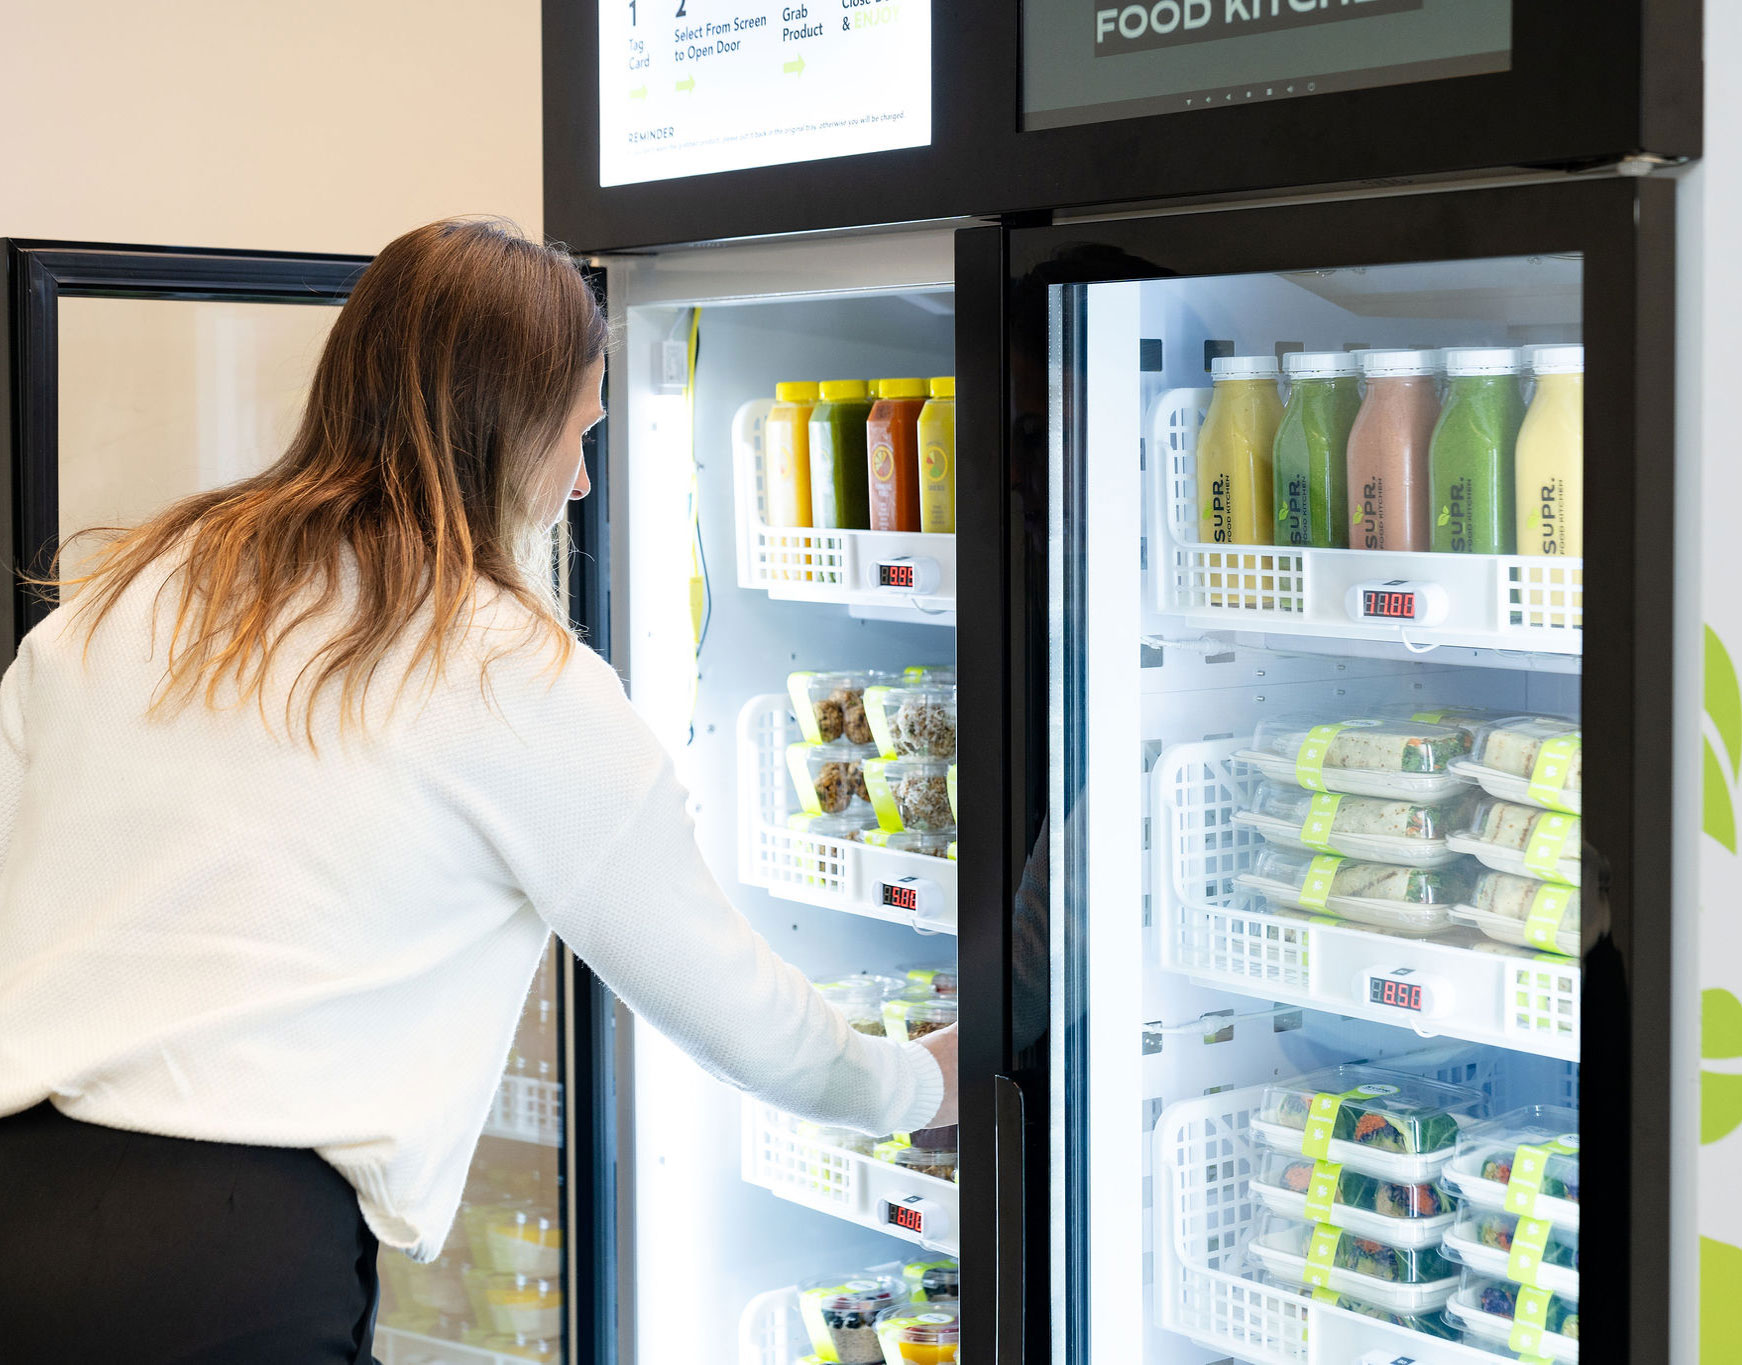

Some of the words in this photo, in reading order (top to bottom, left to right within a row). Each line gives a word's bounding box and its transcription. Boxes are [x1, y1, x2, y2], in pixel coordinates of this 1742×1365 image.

[629, 0, 637, 27] 1
[782, 3, 808, 22] Grab
[842, 16, 850, 31] &
[1096, 0, 1212, 44] FOOD
[674, 26, 703, 43] Select
[706, 22, 731, 37] From
[733, 15, 767, 32] Screen
[782, 22, 823, 42] Product
[629, 39, 644, 53] Tag
[674, 50, 685, 62] to
[687, 45, 714, 61] Open
[716, 40, 741, 54] Door
[629, 52, 650, 70] Card
[628, 126, 675, 143] REMINDER
[1212, 473, 1225, 543] SUPR.
[1289, 473, 1302, 545] SUPR.
[1363, 476, 1378, 549] SUPR.
[1450, 476, 1466, 552] SUPR.
[1541, 477, 1557, 555] SUPR.
[1383, 981, 1422, 1010] 8.50
